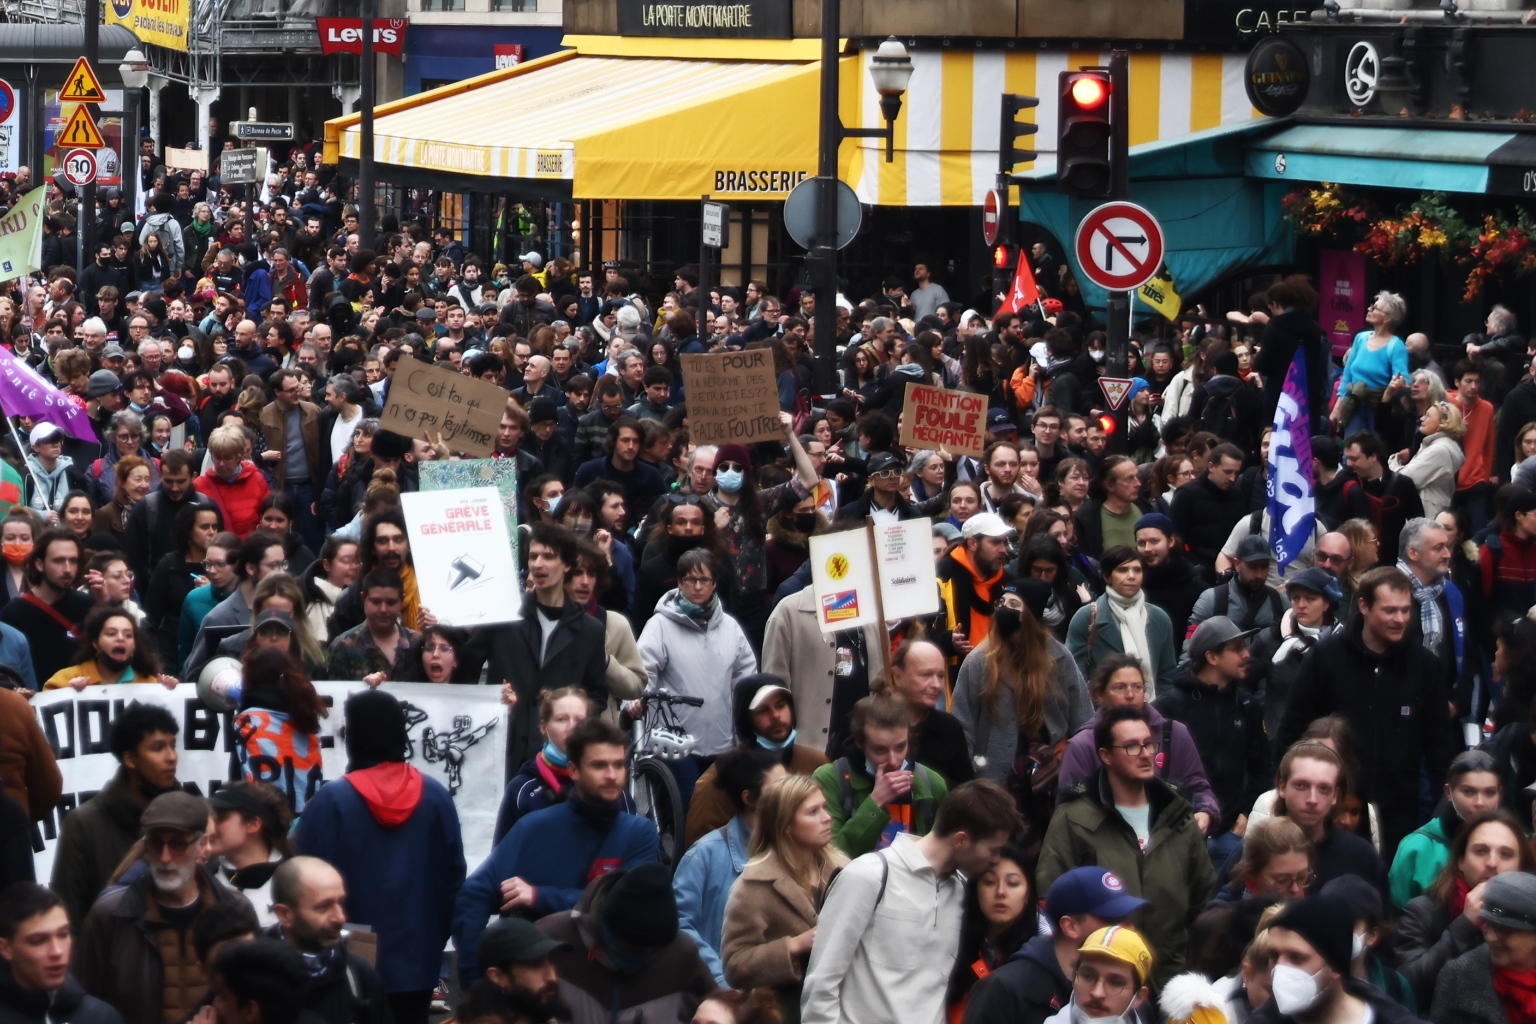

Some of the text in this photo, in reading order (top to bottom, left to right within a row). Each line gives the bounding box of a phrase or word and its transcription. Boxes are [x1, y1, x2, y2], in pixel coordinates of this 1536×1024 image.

[642, 4, 752, 28] LA PORTE MONTMARTRE
[537, 153, 563, 173] BRASSERIE
[722, 352, 766, 373] POUR
[0, 357, 37, 400] Santé
[448, 383, 463, 404] toi
[467, 399, 480, 415] qui
[910, 387, 982, 412] ATTENTION
[727, 415, 782, 439] FOUTRE
[915, 404, 980, 434] FOULE
[890, 575, 917, 585] Solidaires
